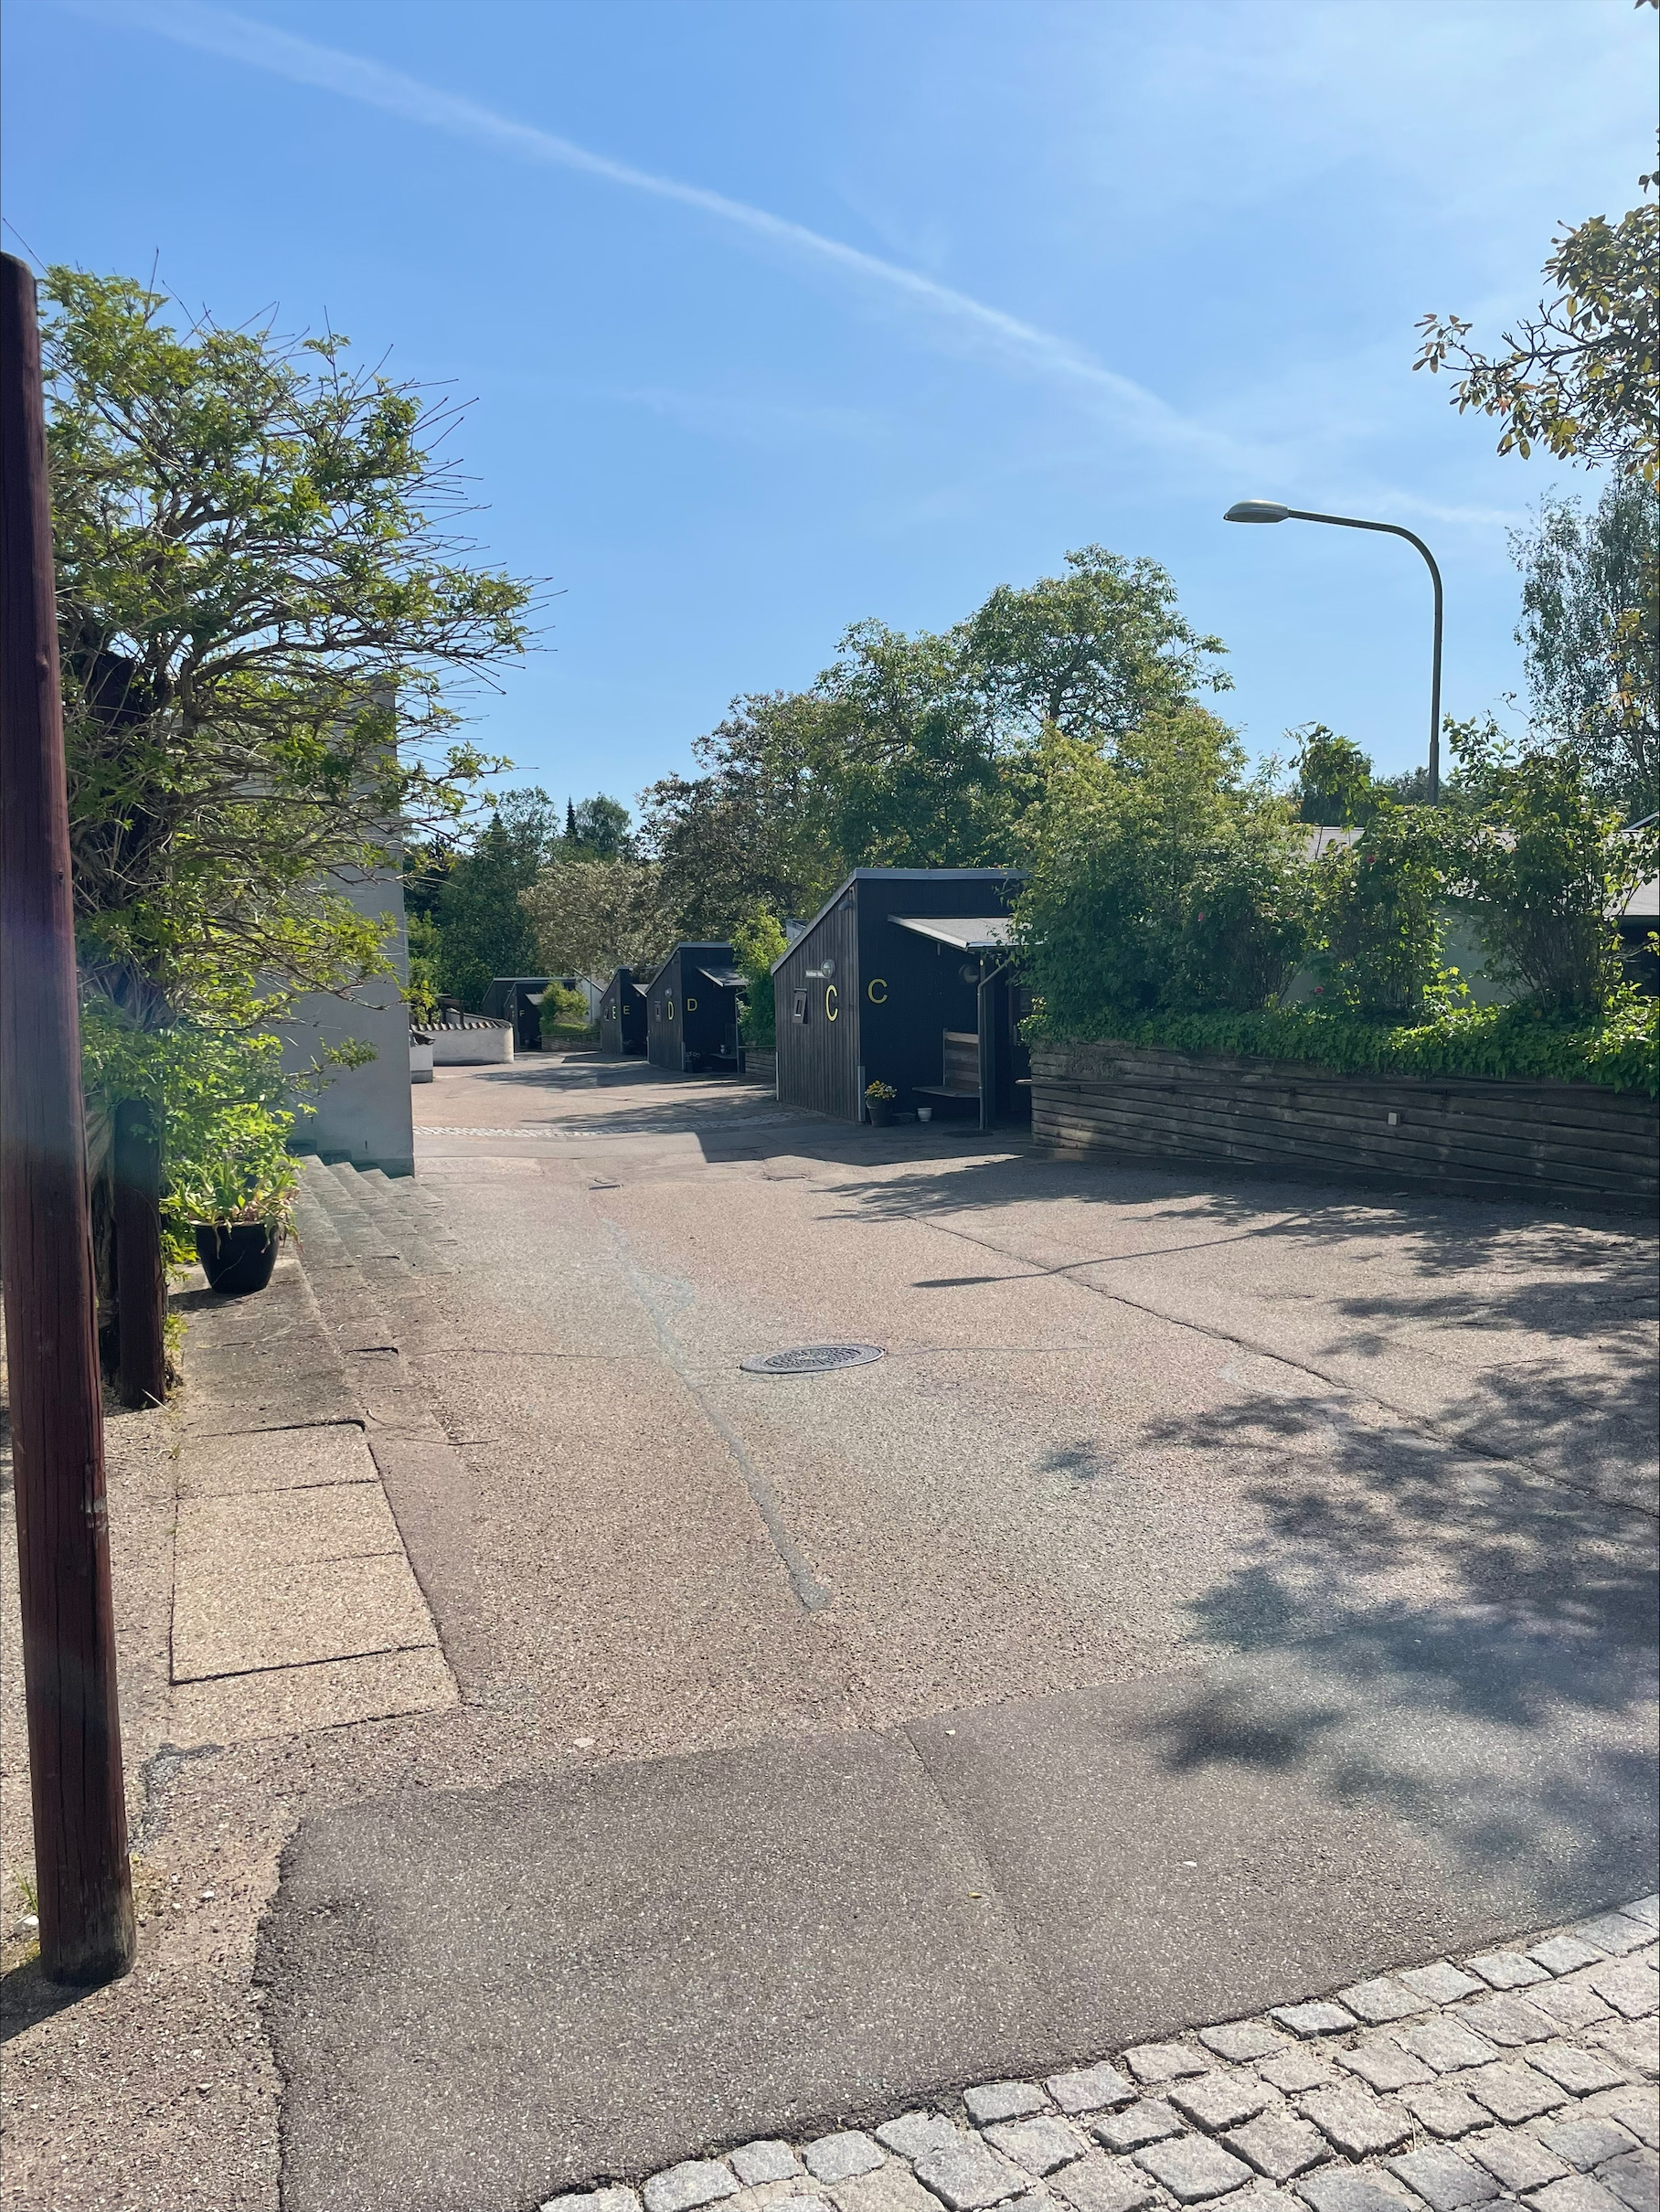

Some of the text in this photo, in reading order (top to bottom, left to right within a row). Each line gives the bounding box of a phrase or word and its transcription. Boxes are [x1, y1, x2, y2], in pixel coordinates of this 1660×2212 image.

[867, 978, 888, 1004] C
[623, 1005, 631, 1015] E
[686, 998, 698, 1012] D
[825, 984, 838, 1022] C
[519, 1009, 526, 1017] F
[612, 1005, 617, 1019] E
[668, 1001, 675, 1020] D
